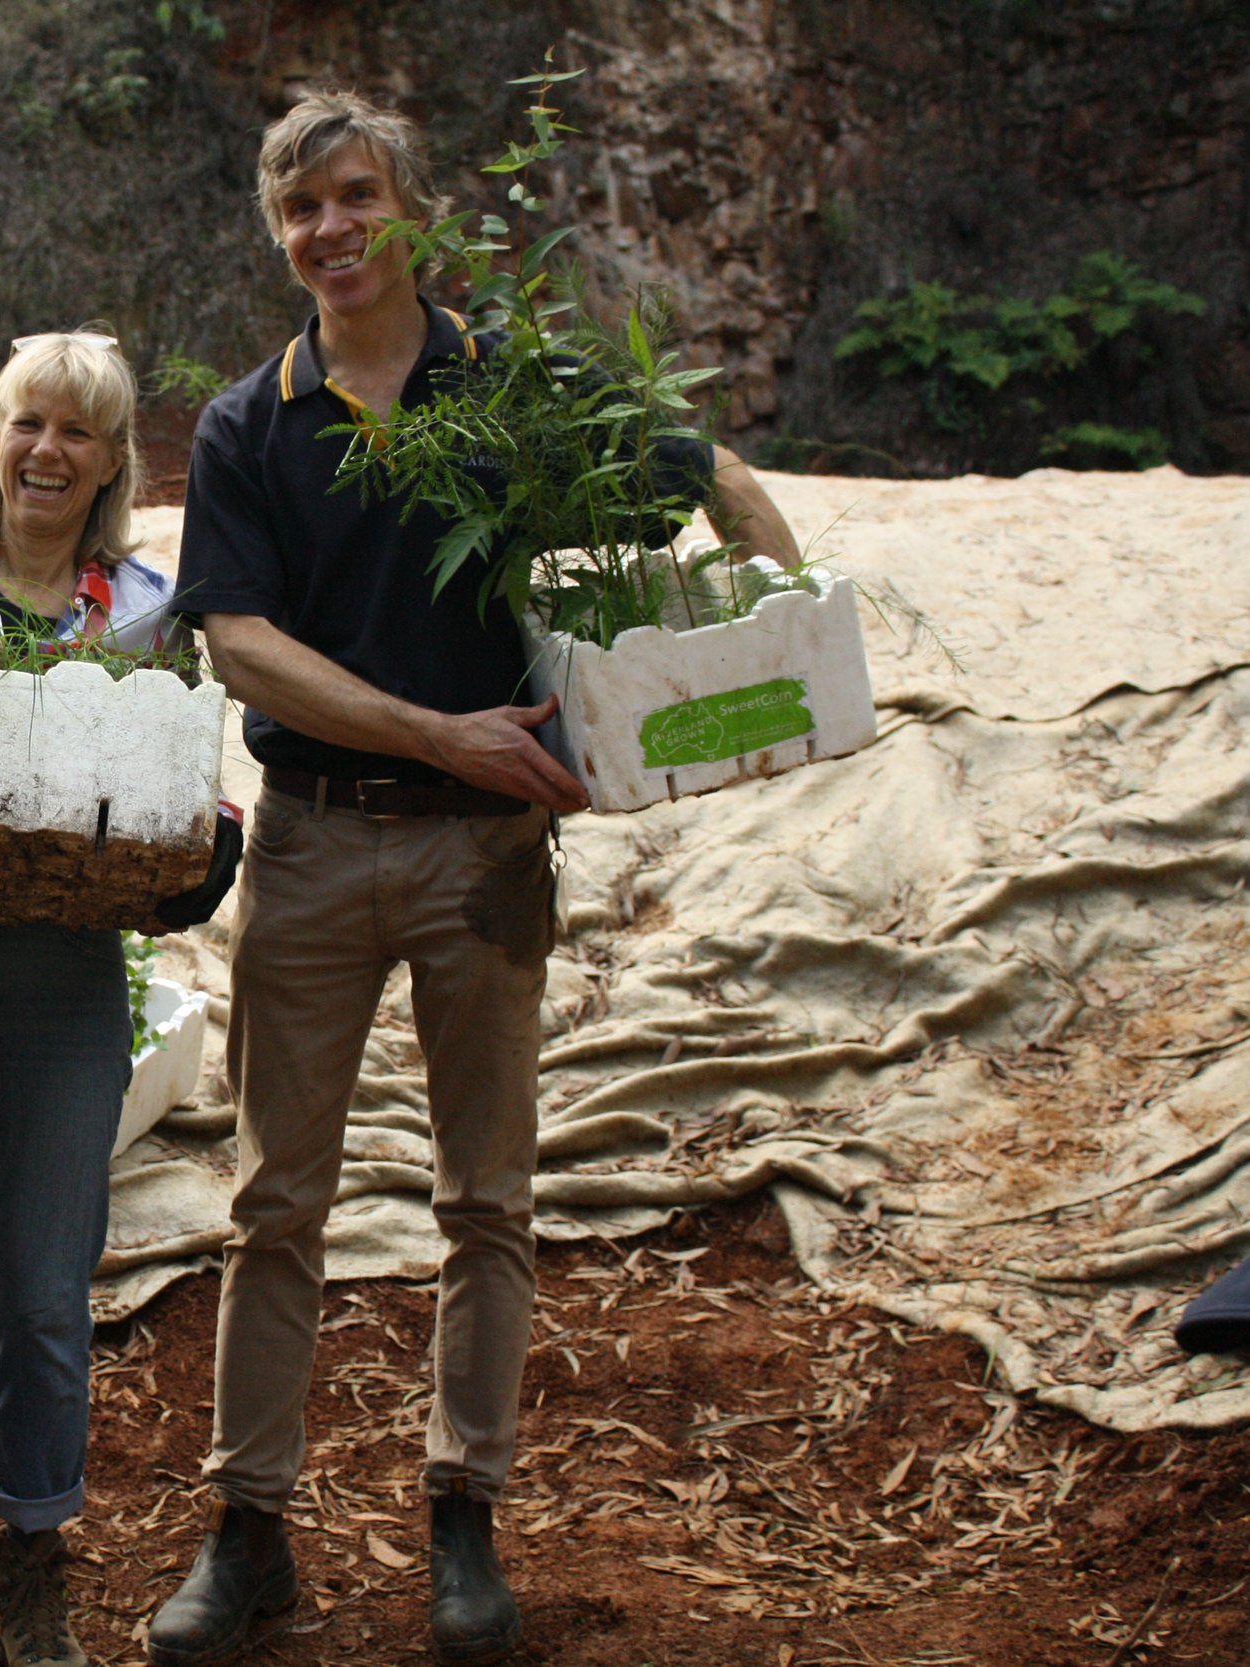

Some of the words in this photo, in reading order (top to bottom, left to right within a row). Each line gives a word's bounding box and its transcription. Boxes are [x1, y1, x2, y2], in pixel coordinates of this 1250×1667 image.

[719, 691, 792, 716] SweetCorn
[654, 715, 713, 742] RIVERLAND
[666, 728, 706, 747] GROWN
